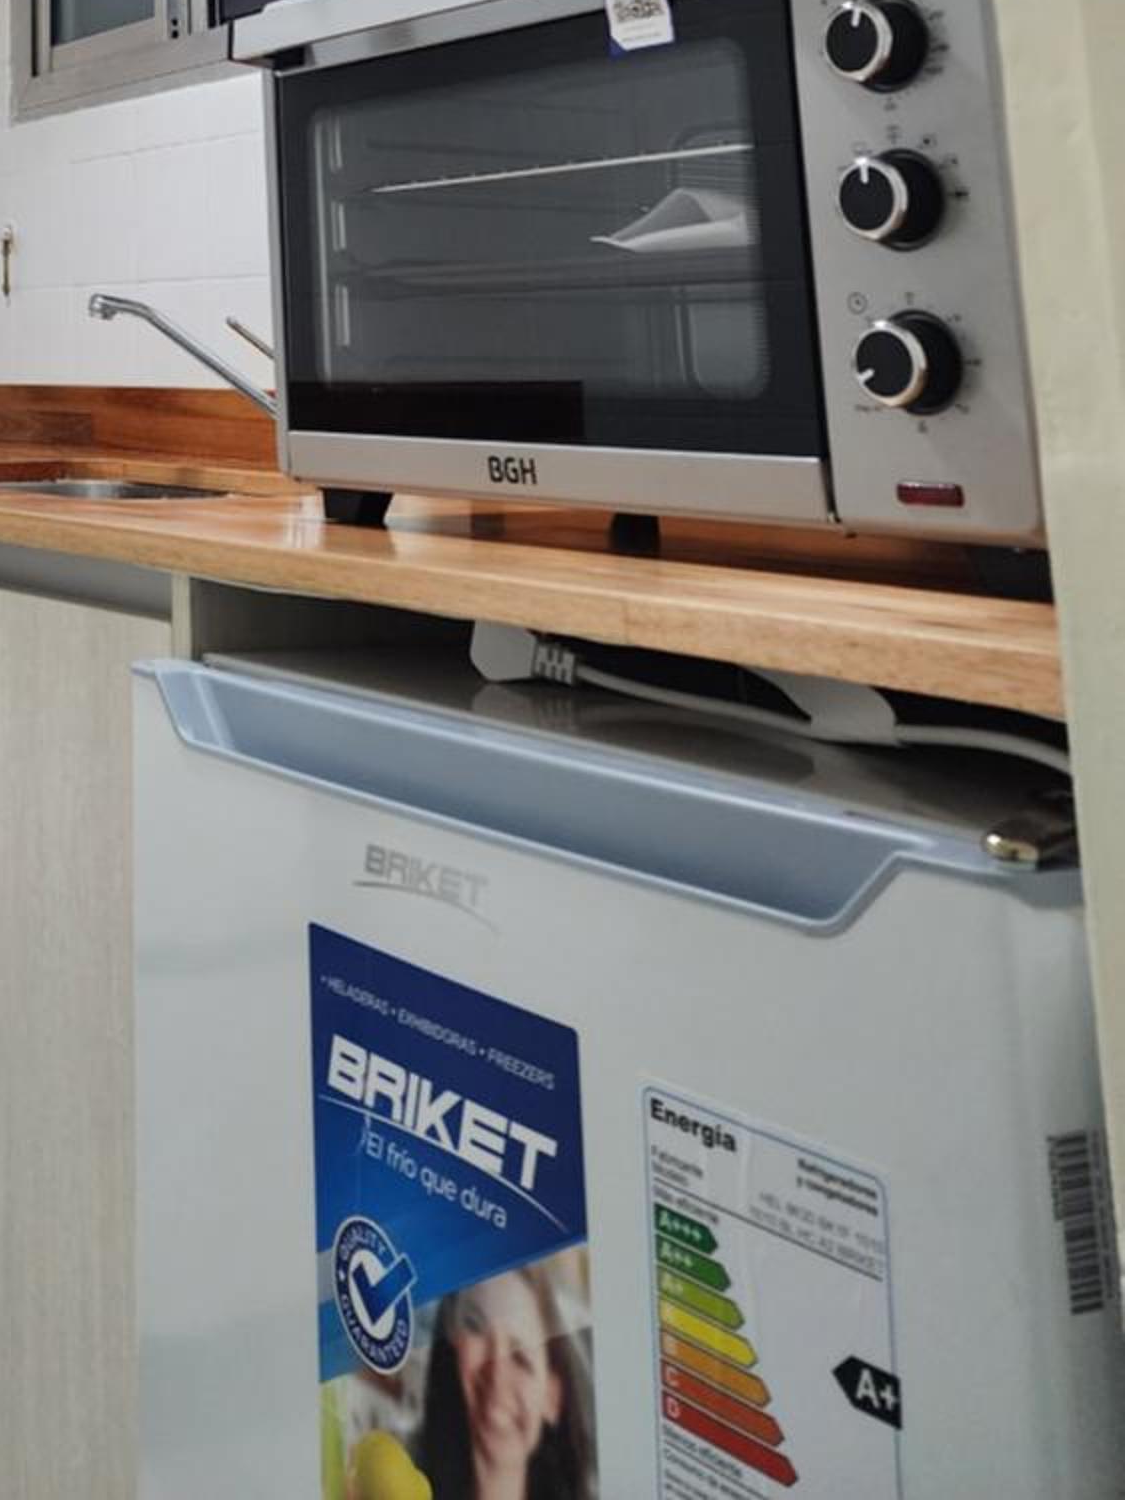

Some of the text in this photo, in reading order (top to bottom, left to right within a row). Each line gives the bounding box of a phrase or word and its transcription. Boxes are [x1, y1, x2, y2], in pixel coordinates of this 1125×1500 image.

[488, 455, 538, 485] BGH
[364, 843, 490, 906] BRIKET
[488, 1048, 555, 1090] FREEZERS
[327, 1033, 558, 1190] BRIKET
[386, 1141, 418, 1179] frío
[420, 1167, 458, 1202] que
[460, 1186, 507, 1229] dura
[856, 1367, 897, 1412] A+
